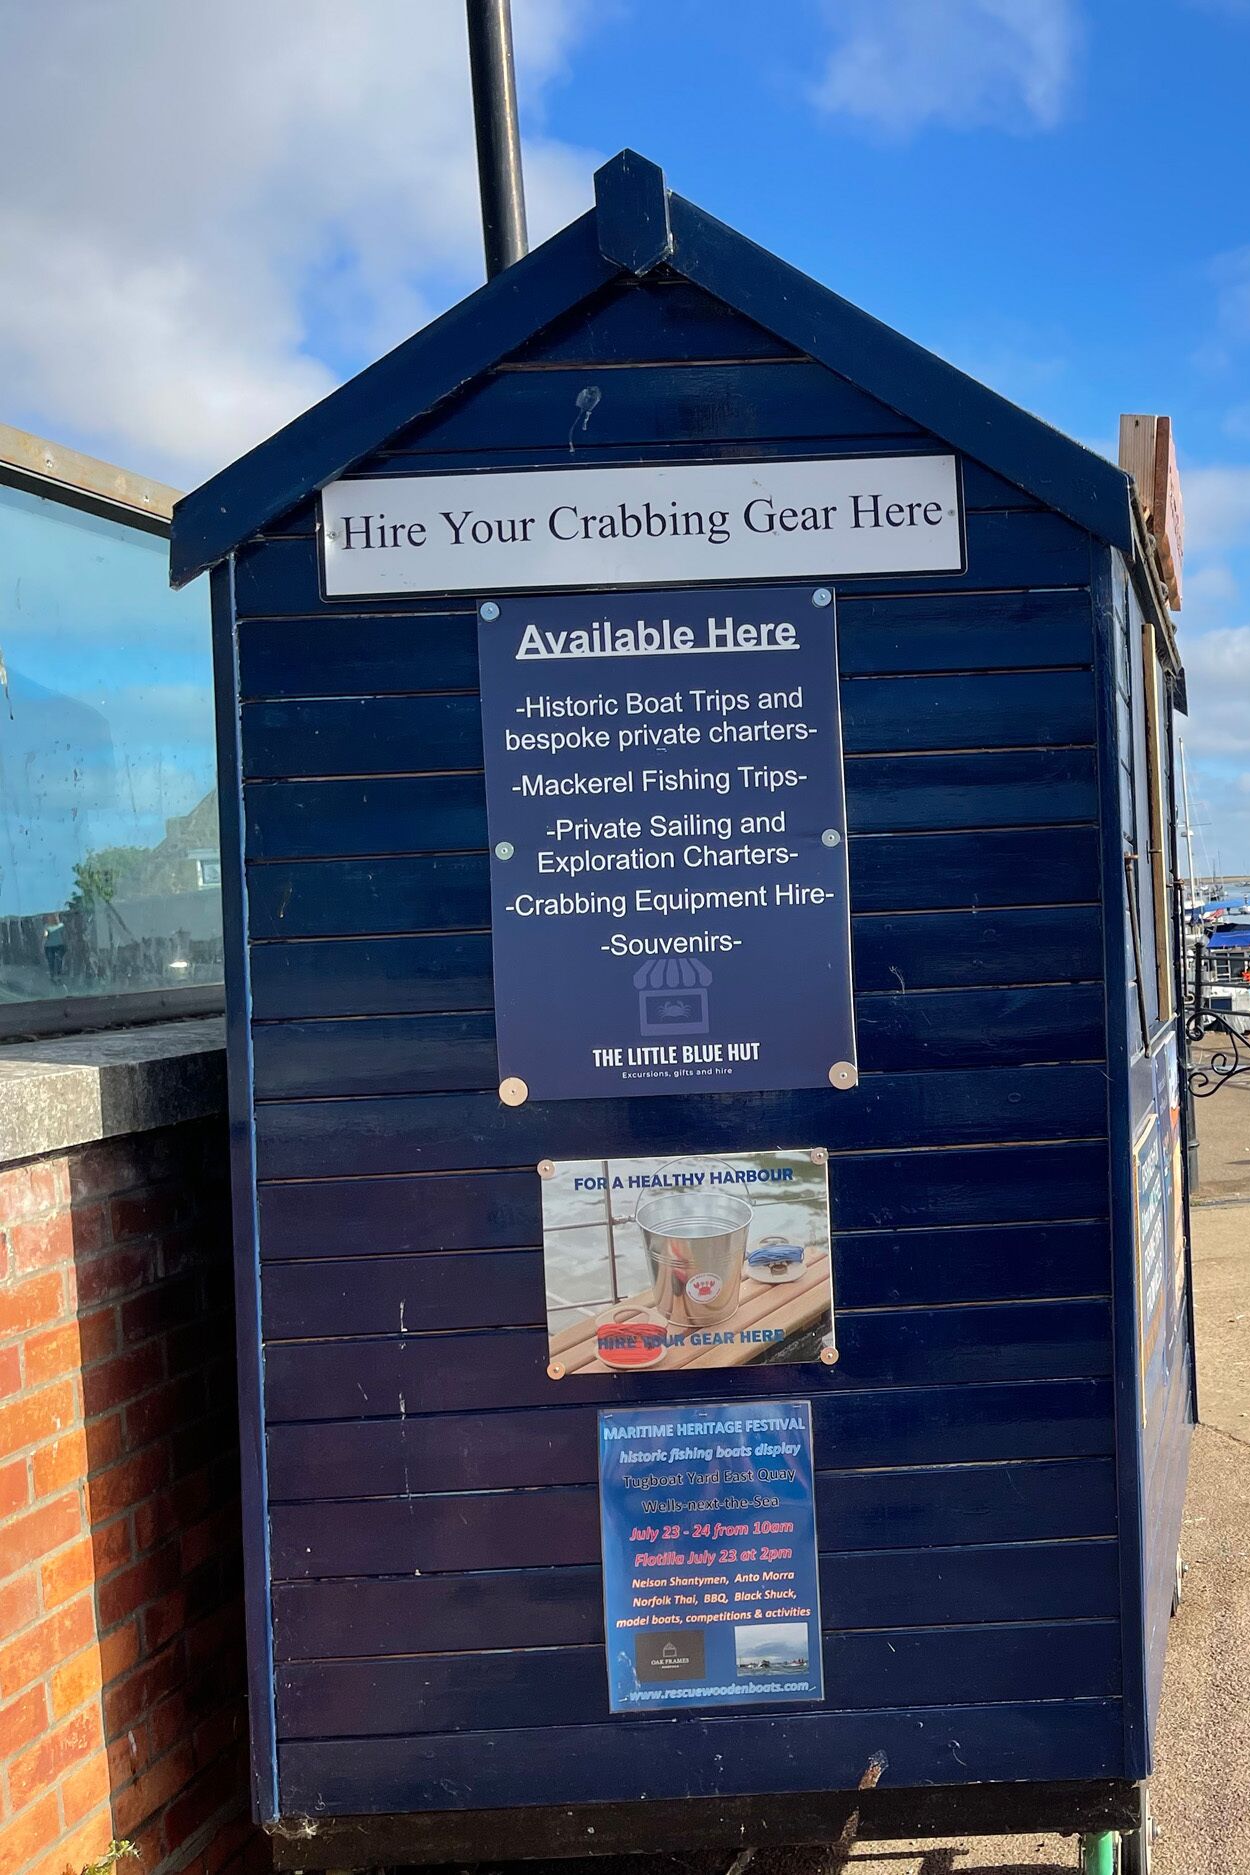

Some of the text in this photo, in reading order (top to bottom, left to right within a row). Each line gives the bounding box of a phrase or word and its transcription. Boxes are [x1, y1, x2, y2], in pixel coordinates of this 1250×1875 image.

[341, 492, 943, 551] Hire Your Crabbing Gear Here
[516, 617, 797, 658] Available Here
[516, 687, 803, 720] -Historic Boat Trips and
[505, 720, 817, 753] bespoke private charters-
[512, 766, 807, 798] -Mackerel Fishing Trips-
[546, 812, 786, 843] -Private Sailing and
[538, 845, 799, 876] Exploration Charters-
[506, 884, 834, 918] -Crabbing Equipment Hire-
[601, 931, 742, 957] -Souvenirs-
[593, 1042, 760, 1067] THE LITTLE BLUE HUT
[622, 1070, 672, 1079] Excursions,
[674, 1068, 694, 1078] gifts
[716, 1066, 732, 1074] hire
[574, 1168, 794, 1191] FOR A HEALTHY HARBOUR
[598, 1328, 786, 1350] HIRE YOUR GEAR HERE
[604, 1418, 806, 1440] MARITIME HERITAGE FESTIVAL
[620, 1442, 800, 1464] historic fishing boats display
[623, 1468, 796, 1490] Tugboat Yard East Quay
[642, 1495, 780, 1514] Wells-next-the-Sea
[629, 1526, 659, 1542] July
[662, 1525, 680, 1540] 23
[692, 1524, 710, 1538] 24
[712, 1522, 748, 1540] from
[752, 1521, 794, 1535] 10am
[634, 1546, 792, 1568] Flotilla July 23 at 2pm
[632, 1571, 795, 1589] Nelson Shantymen, Anto Morra
[633, 1588, 796, 1608] Norfolk Thai, BBQ, Black Shuck,
[616, 1606, 811, 1628] model boats, competitions & activities
[630, 1682, 808, 1700] www.rescuewoodenboats.com
